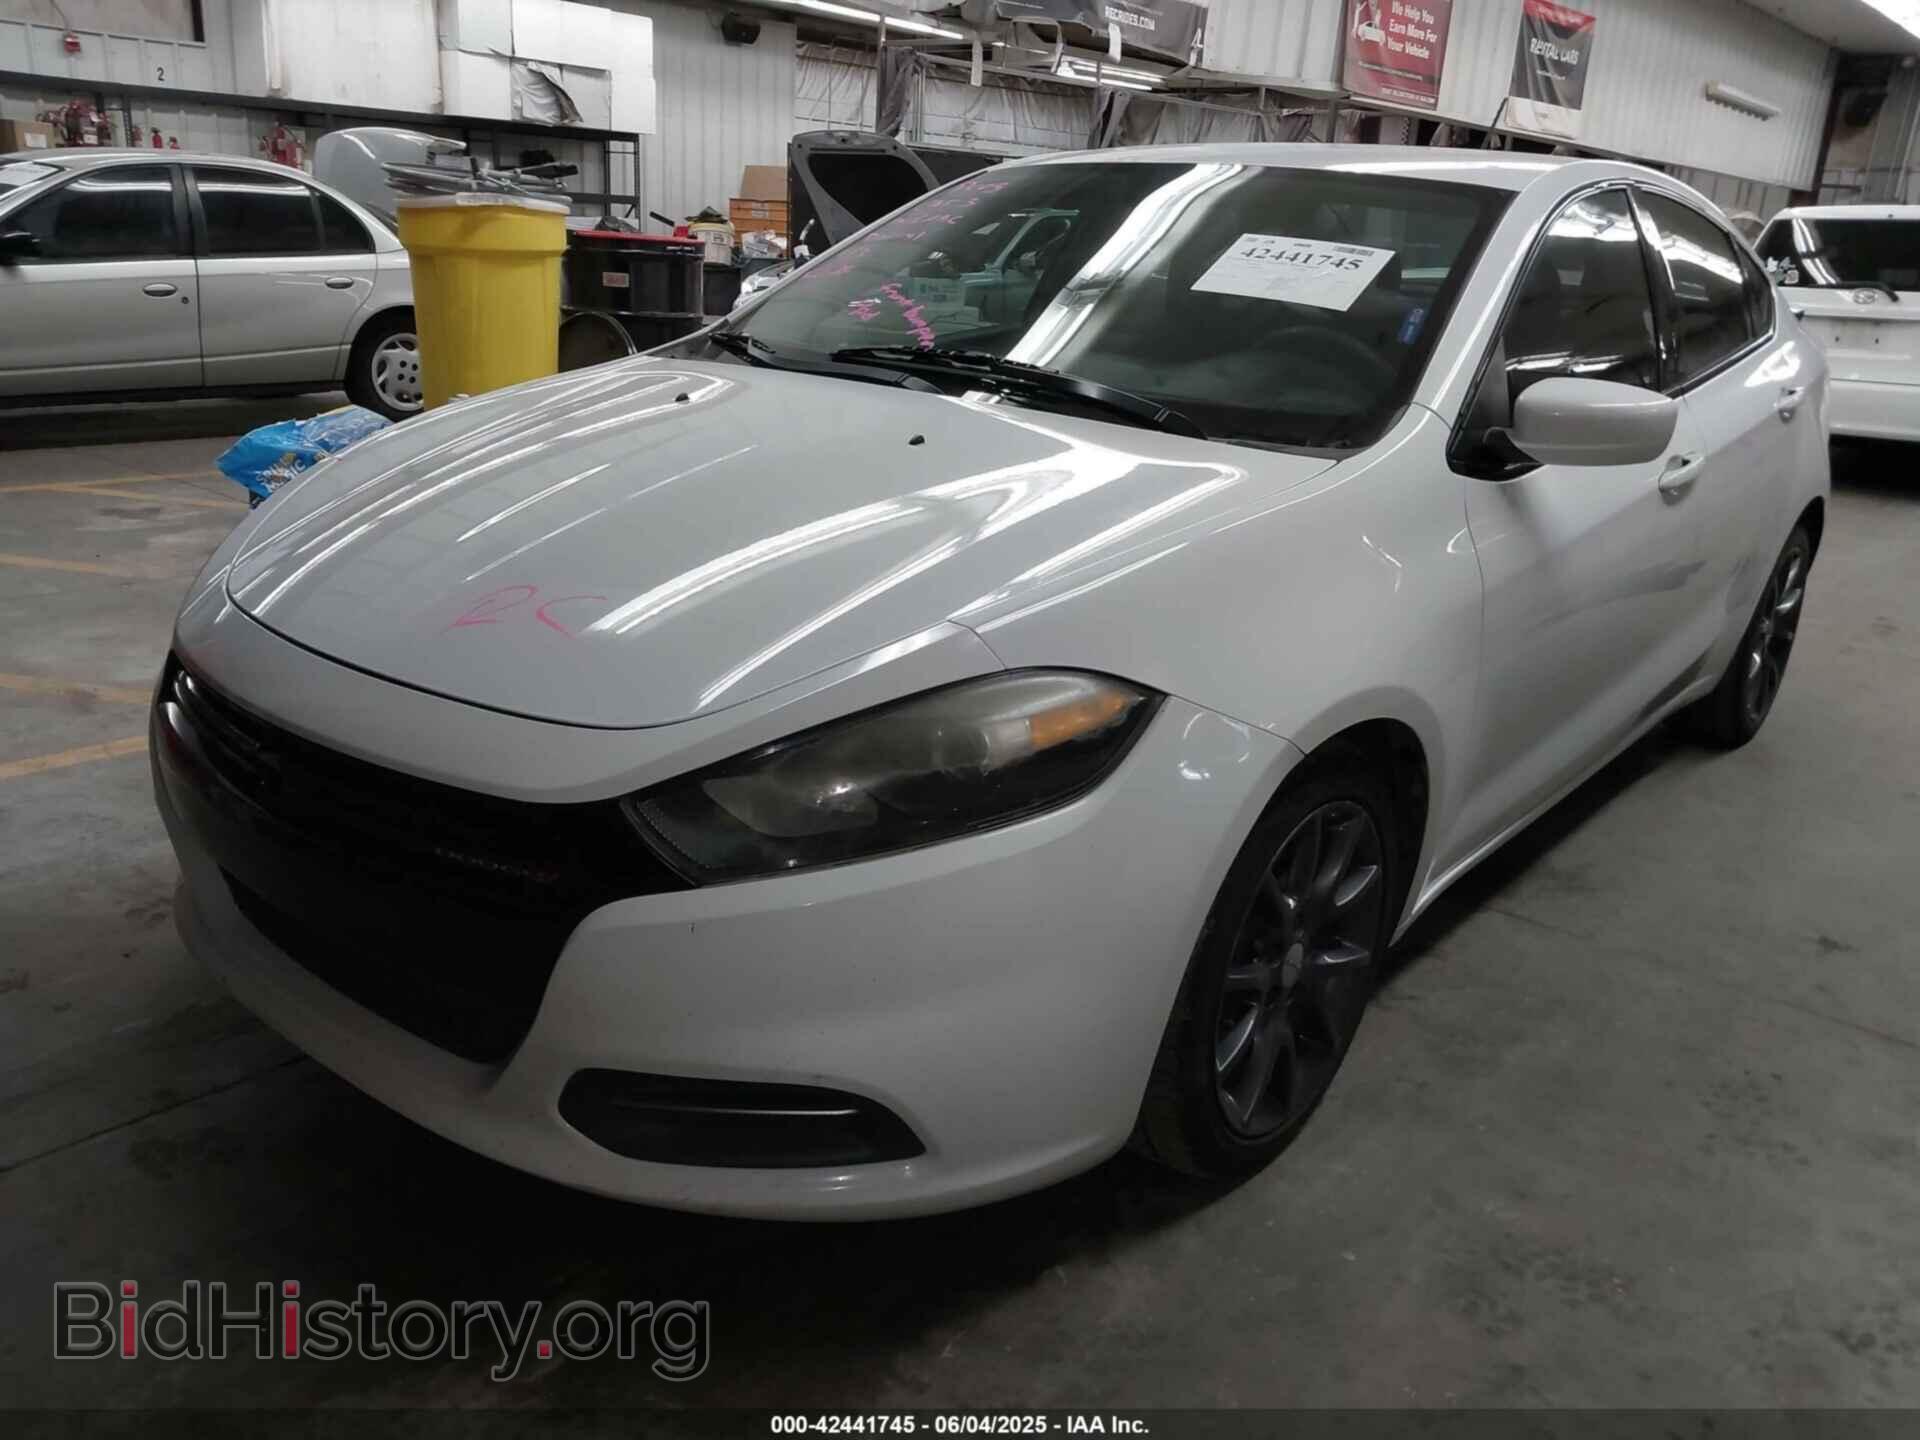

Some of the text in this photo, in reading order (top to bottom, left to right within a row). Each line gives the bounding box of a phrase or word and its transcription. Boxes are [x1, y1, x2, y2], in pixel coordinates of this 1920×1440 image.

[1404, 4, 1421, 23] Help
[1422, 8, 1435, 25] You
[1406, 23, 1425, 41] More
[1425, 28, 1438, 43] For
[1405, 40, 1430, 59] Vehicle
[156, 67, 165, 82] 2
[1241, 247, 1364, 271] 42441745
